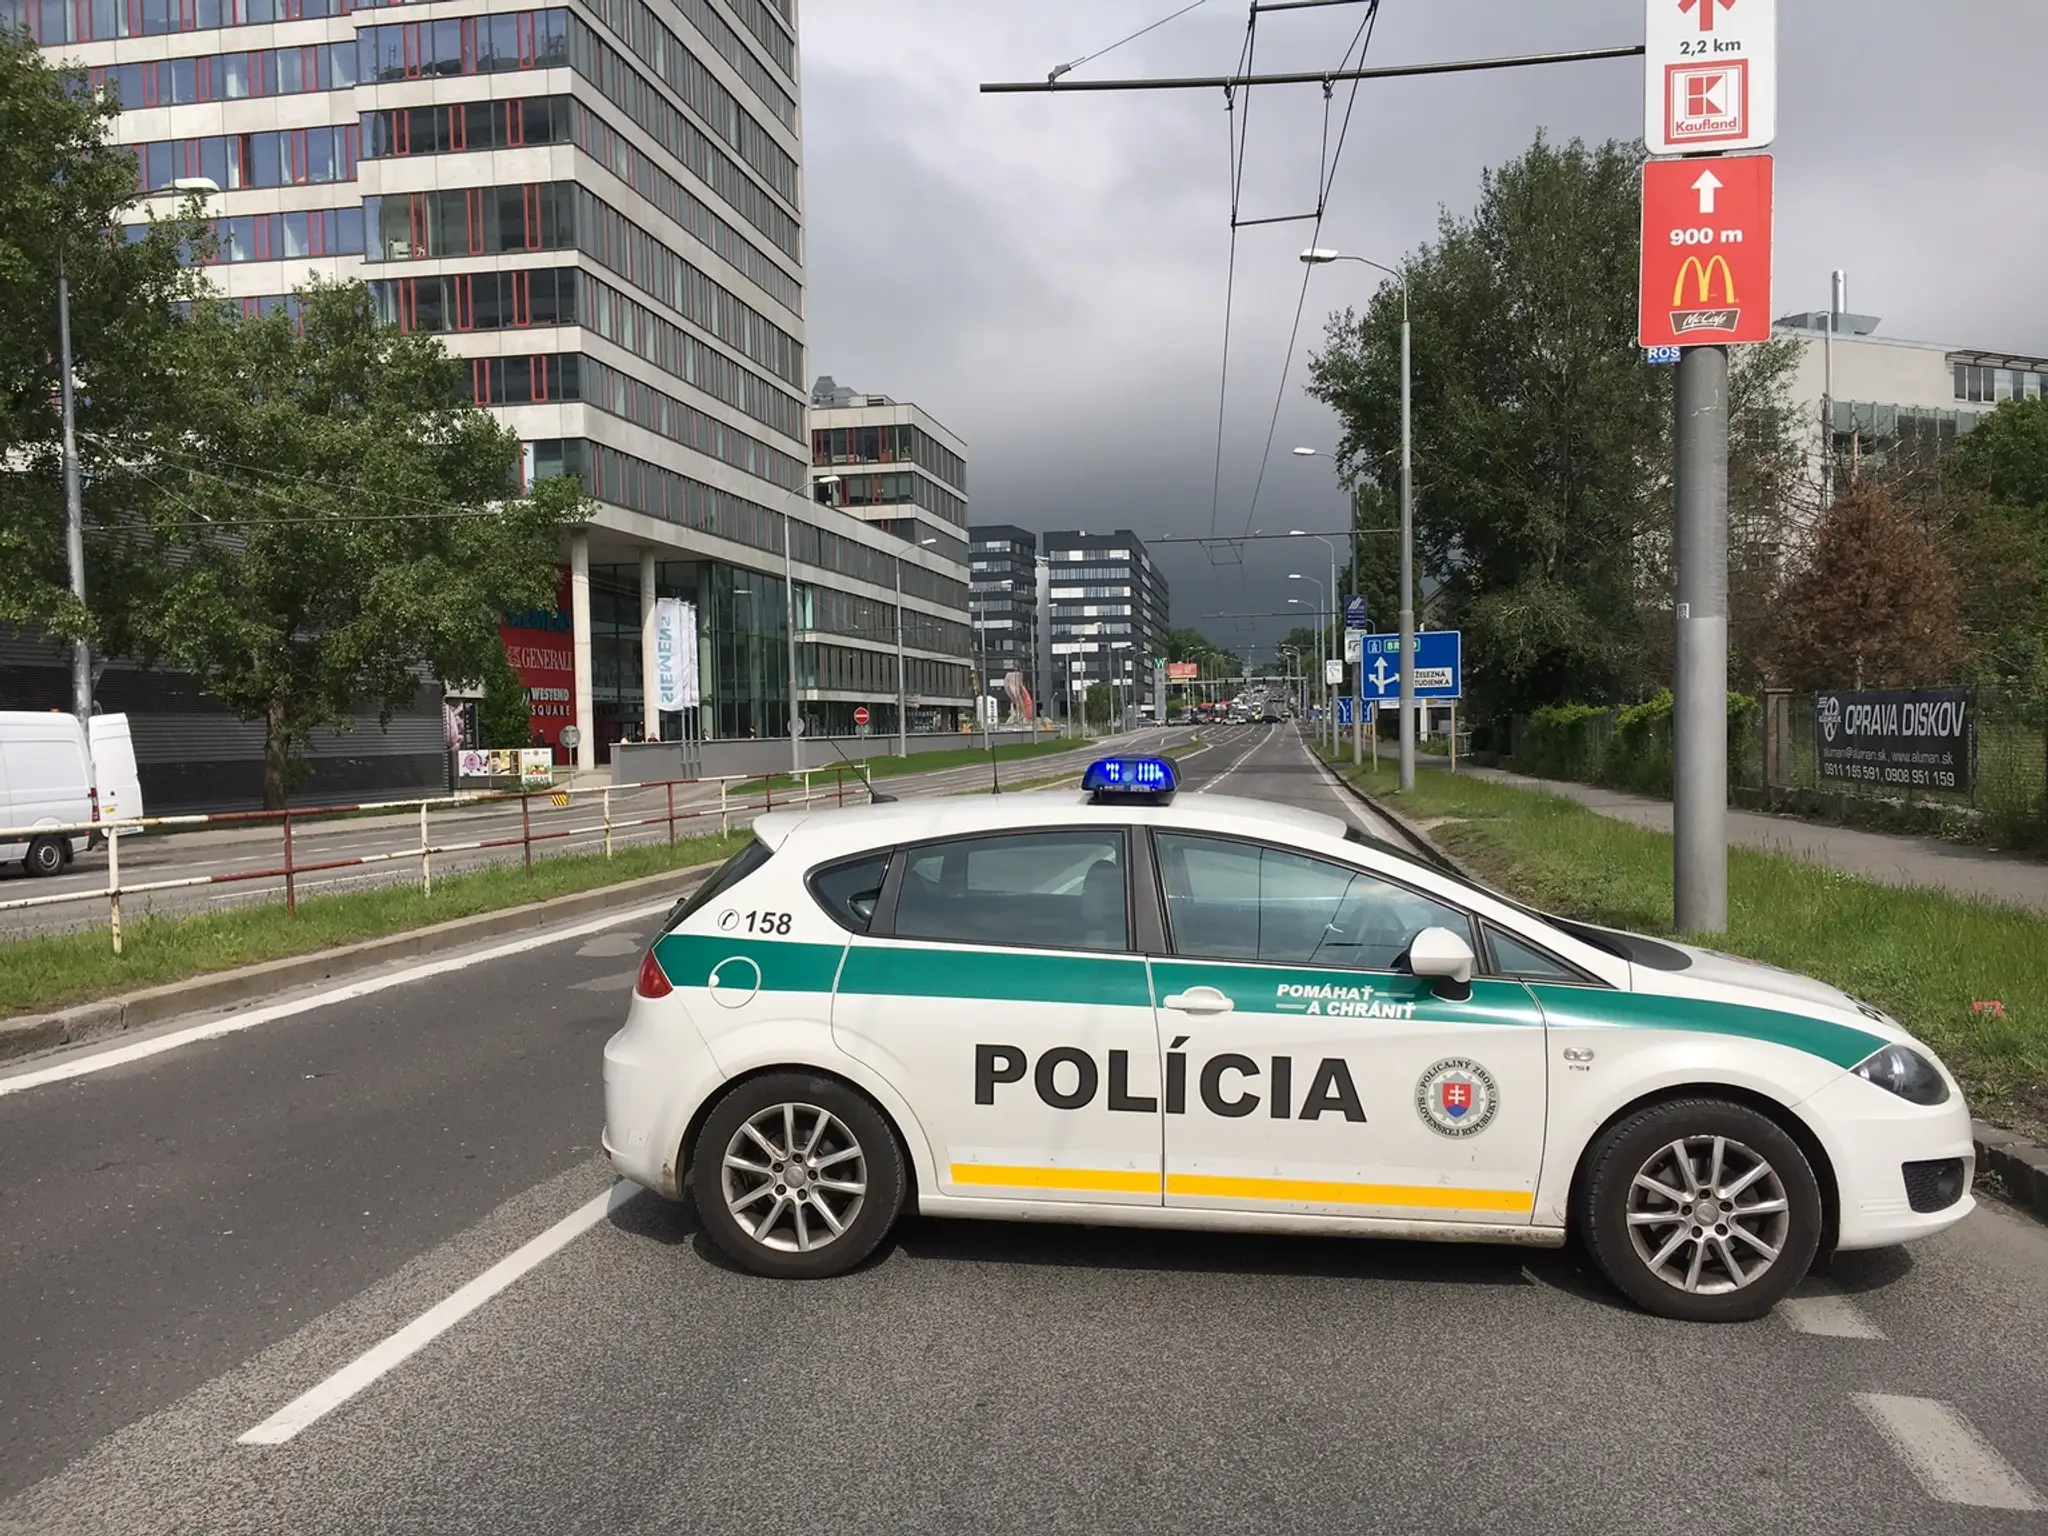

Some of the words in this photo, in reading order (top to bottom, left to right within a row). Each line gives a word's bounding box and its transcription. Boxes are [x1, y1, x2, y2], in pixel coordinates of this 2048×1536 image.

[1680, 41, 1707, 56] 2,2
[1714, 38, 1741, 52] km
[1676, 116, 1737, 132] Kaufland
[1670, 227, 1714, 246] 900
[1720, 229, 1743, 243] m
[1648, 346, 1680, 358] ROS
[522, 647, 572, 671] GENERALI
[1414, 679, 1450, 687] TUDIENKA
[530, 687, 569, 701] WESTEND
[531, 704, 570, 716] SQUARE
[1845, 704, 1898, 736] OPRAVA
[1902, 702, 1965, 737] DISKOV
[1885, 768, 1909, 783] 0908
[1912, 769, 1929, 785] 951
[1933, 771, 1955, 787] 159
[746, 911, 792, 935] 158
[1277, 983, 1374, 1000] POMÁHAŤ
[1306, 1001, 1320, 1014] A
[1327, 1000, 1416, 1019] CHRÁNIŤ
[975, 1036, 1367, 1123] POLÍCIA
[1420, 1060, 1471, 1088] POLICAJNÝ
[1472, 1066, 1495, 1091] ZBOR
[1418, 1097, 1460, 1136] SLOVENSKEJ
[1461, 1098, 1497, 1136] REPUBLIKY
